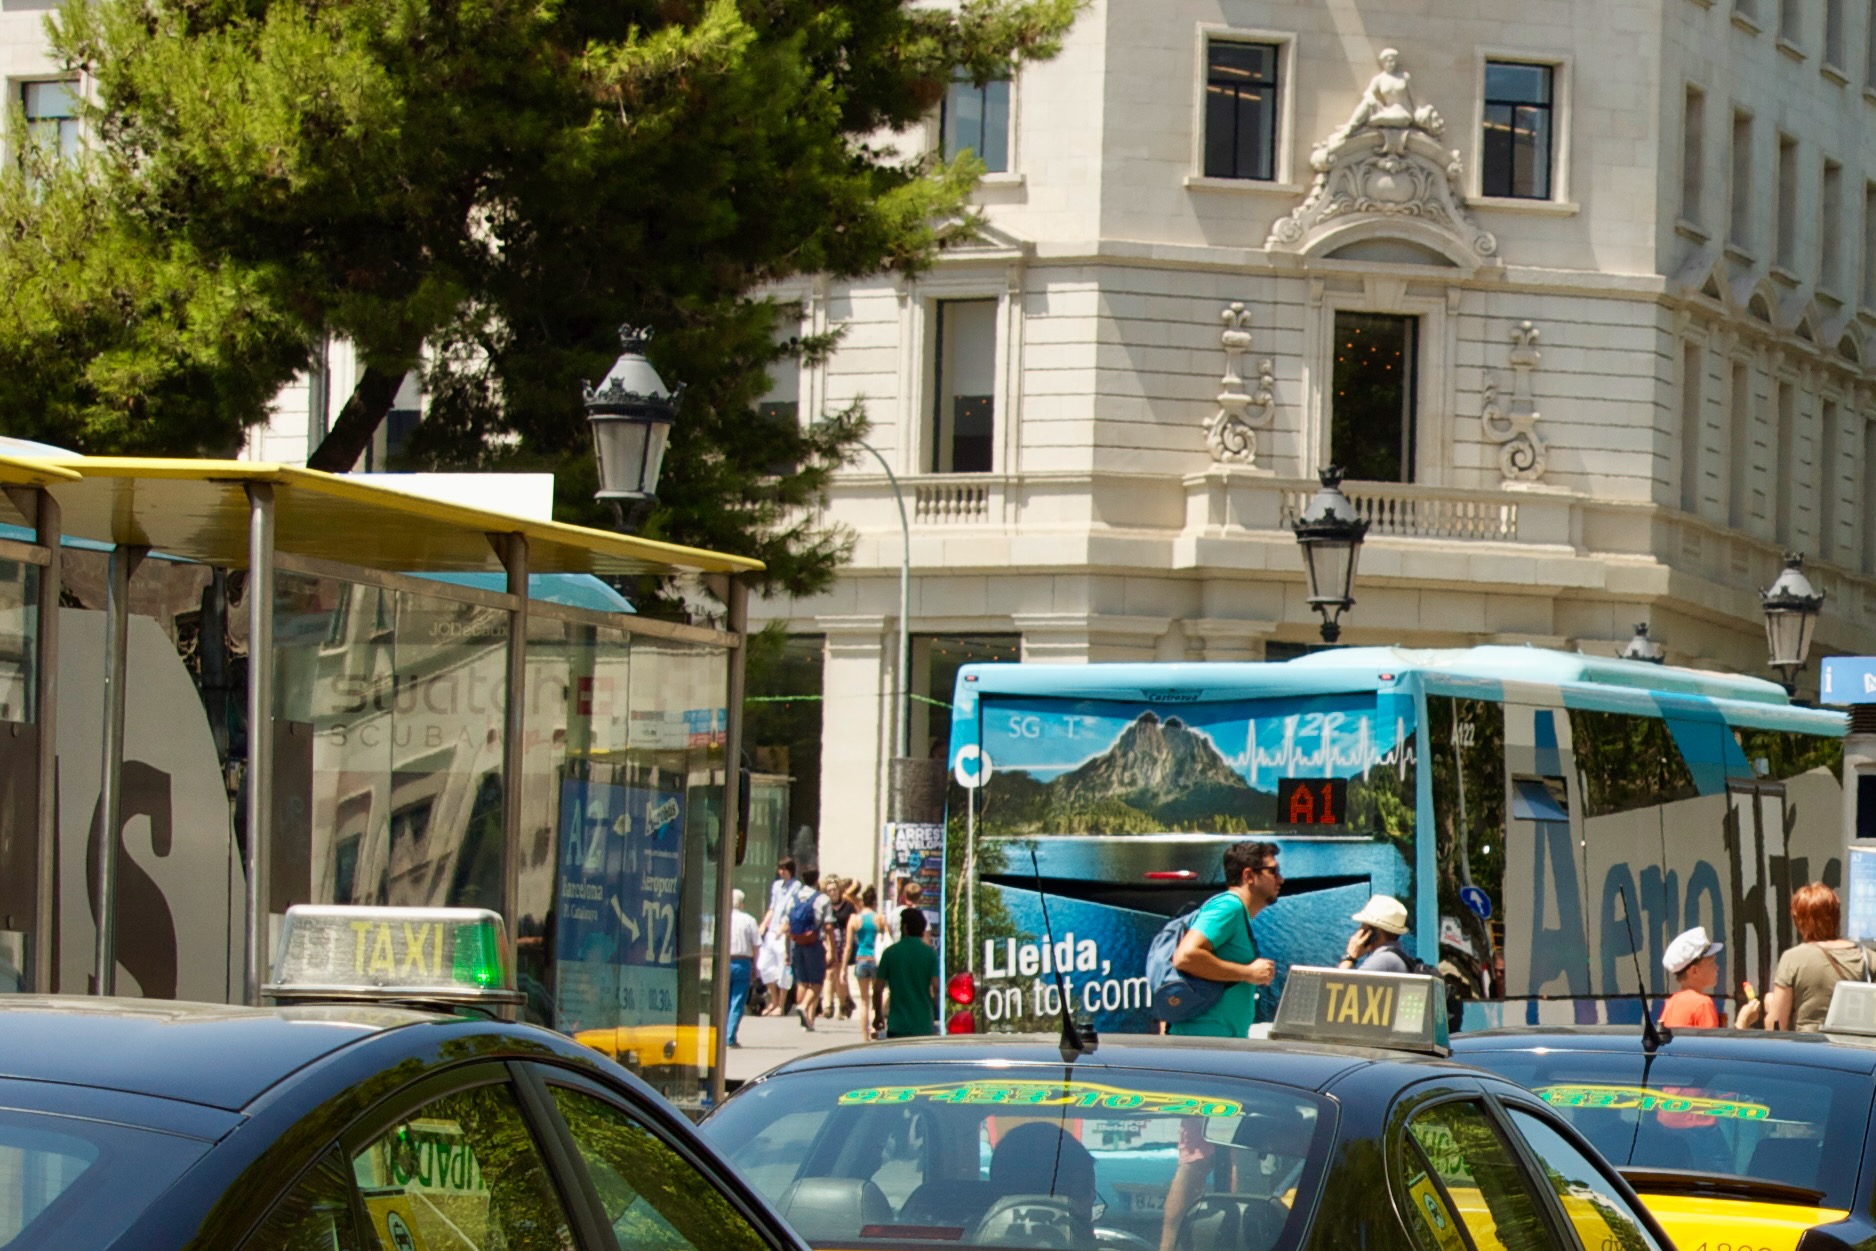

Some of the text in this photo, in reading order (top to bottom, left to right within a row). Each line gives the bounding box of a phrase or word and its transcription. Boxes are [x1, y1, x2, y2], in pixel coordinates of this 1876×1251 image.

[1008, 715, 1041, 739] SG
[1289, 782, 1336, 824] A1
[351, 921, 443, 977] TAXI
[642, 900, 675, 964] T2
[984, 932, 1111, 978] Lleida,
[985, 987, 1022, 1020] on
[1083, 977, 1152, 1012] com
[1326, 982, 1393, 1027] TAXI
